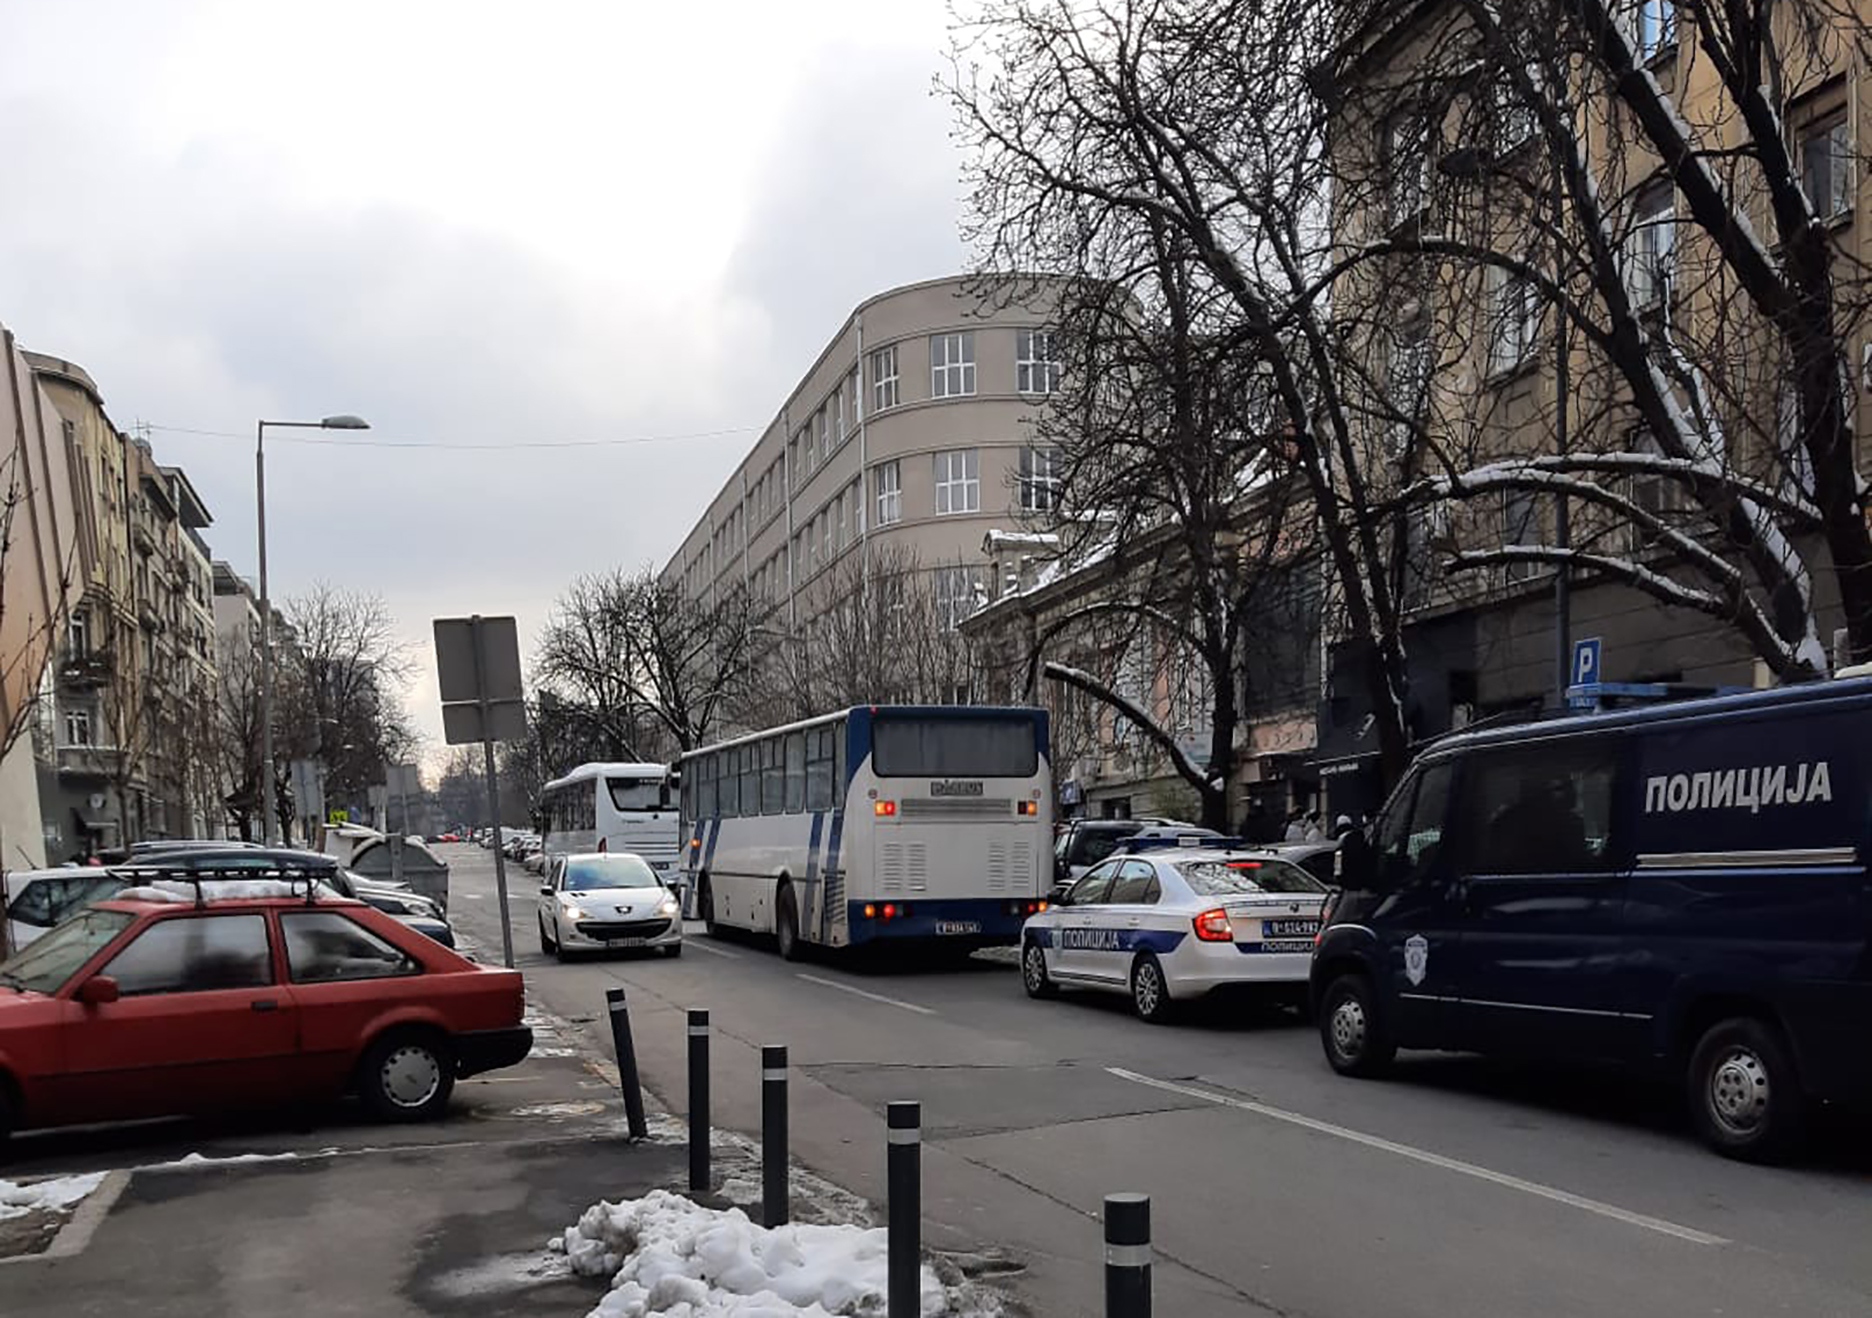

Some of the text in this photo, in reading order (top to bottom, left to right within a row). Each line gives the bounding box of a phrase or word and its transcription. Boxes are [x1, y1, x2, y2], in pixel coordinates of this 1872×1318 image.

[1578, 647, 1593, 683] P
[1645, 761, 1832, 813] ПОЛИЦИЈА
[1063, 929, 1120, 949] ПОЛИЦИЈА
